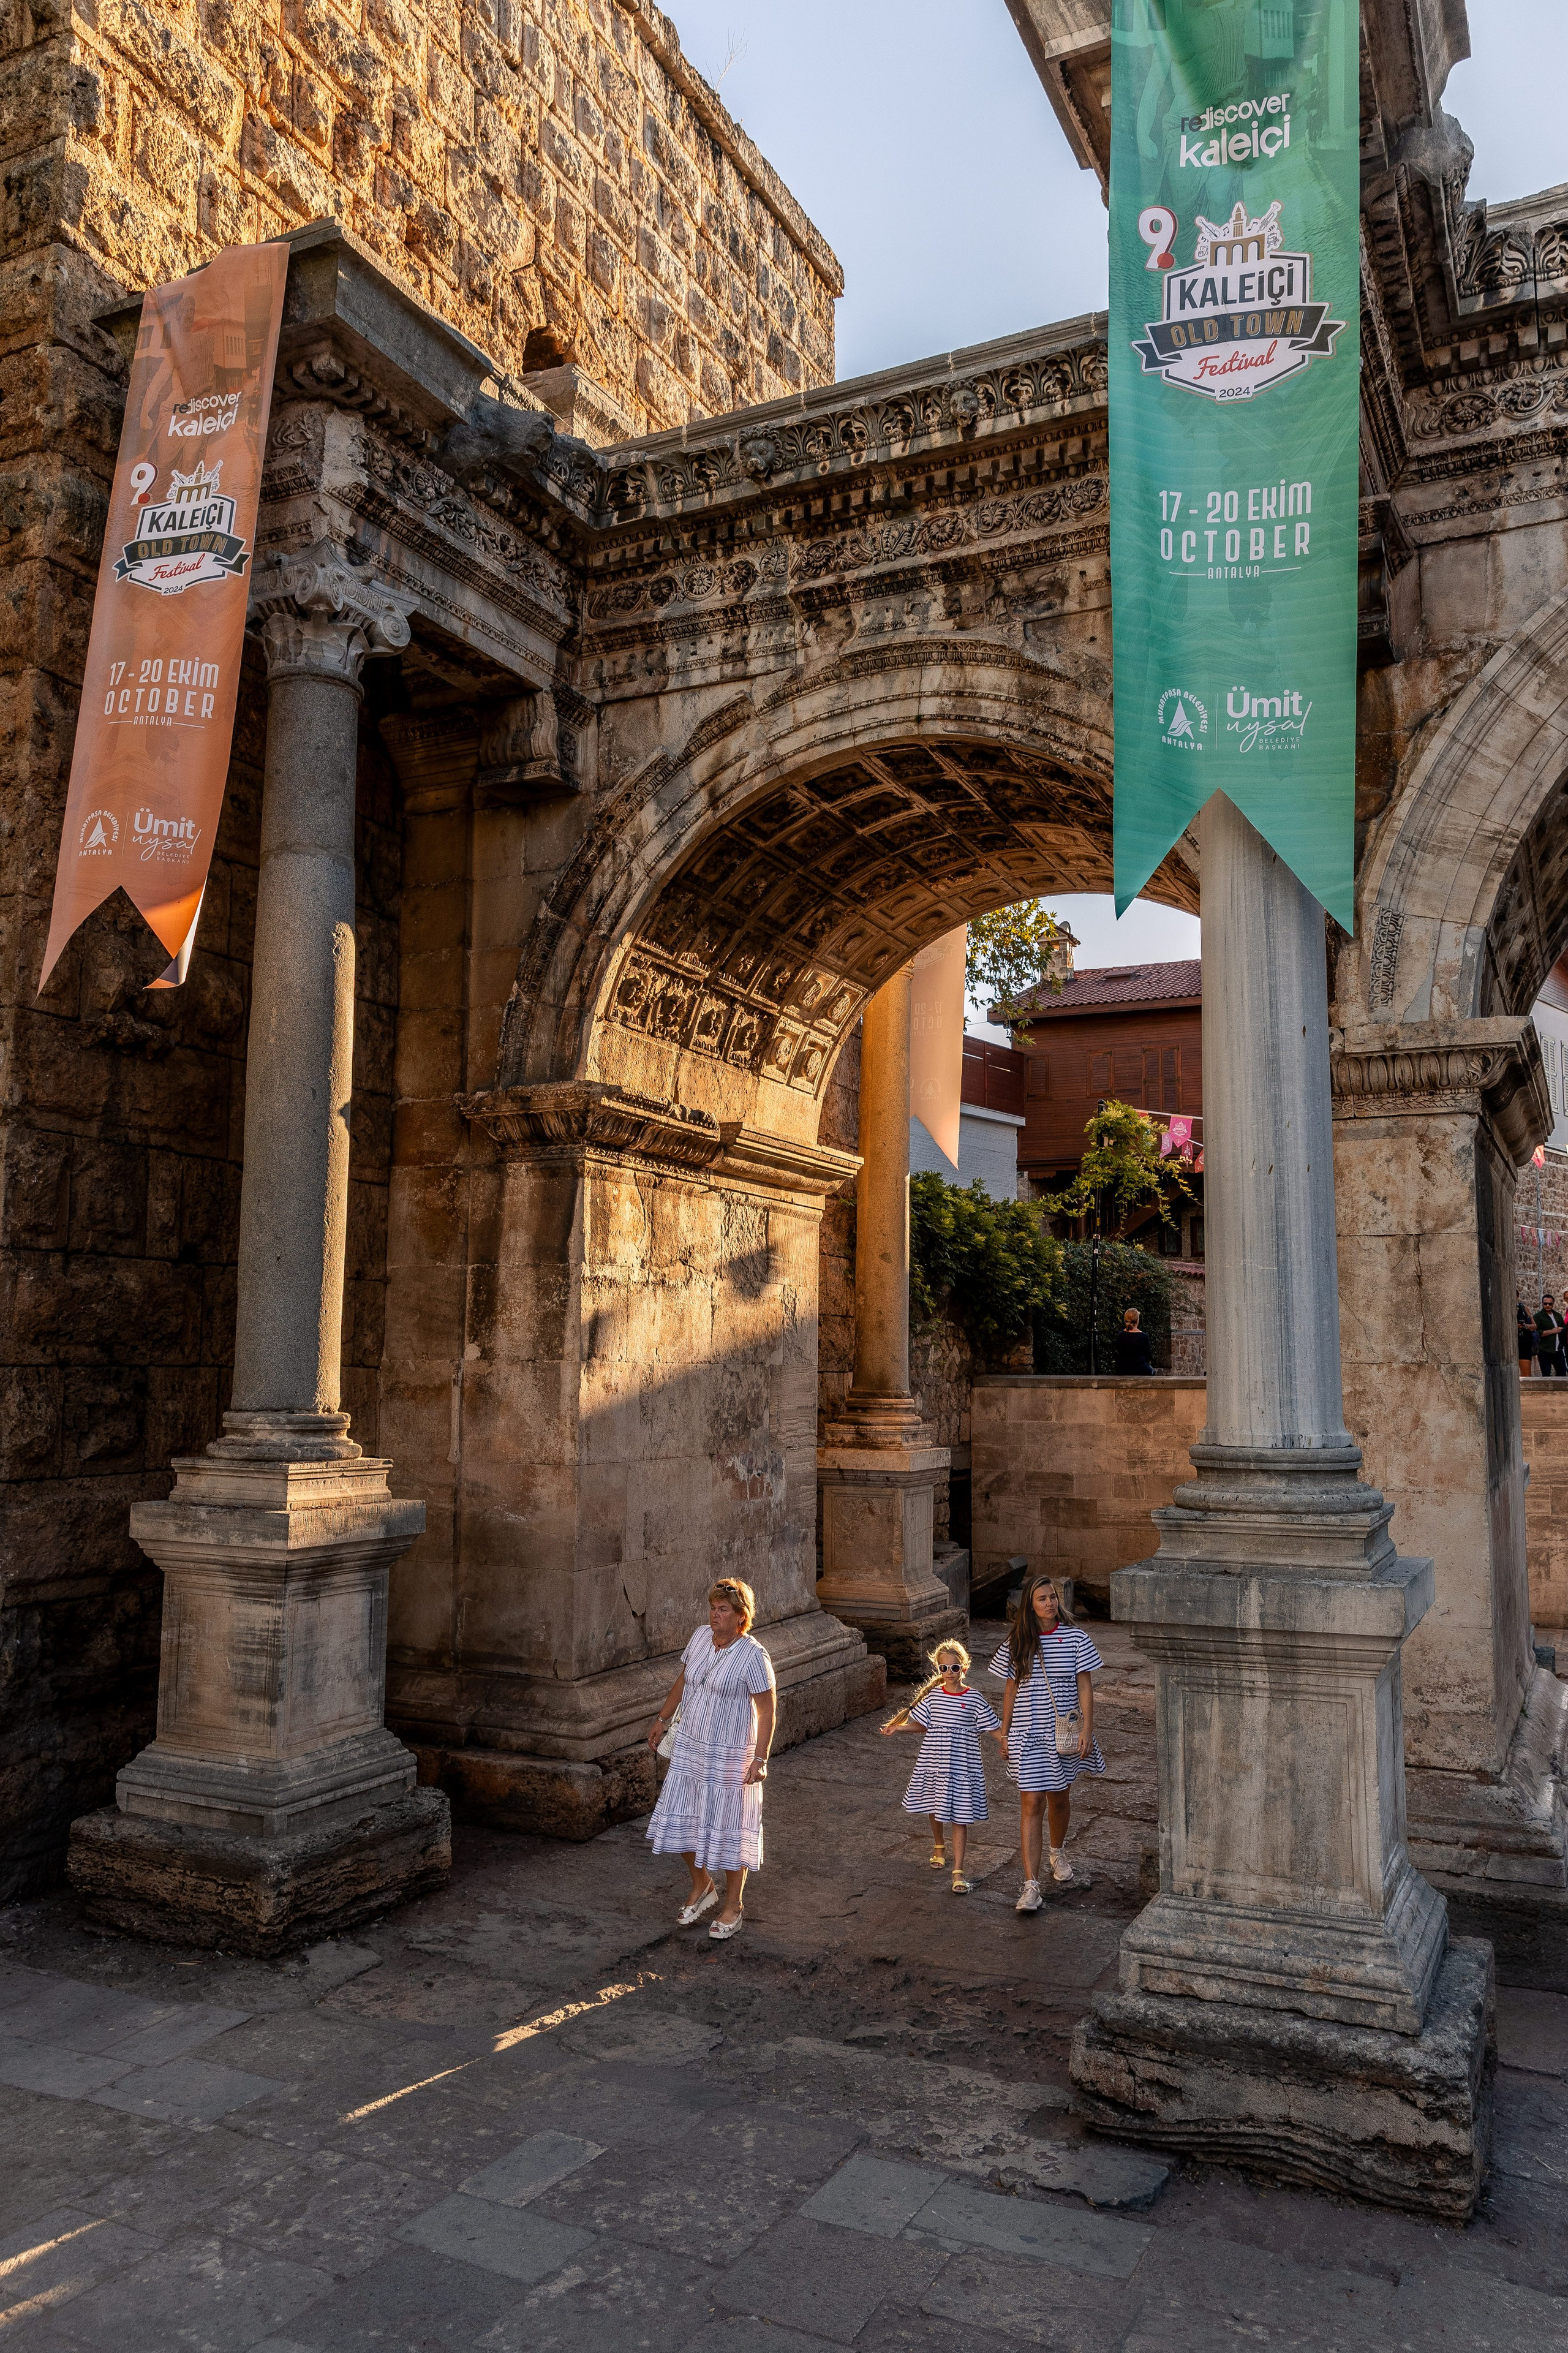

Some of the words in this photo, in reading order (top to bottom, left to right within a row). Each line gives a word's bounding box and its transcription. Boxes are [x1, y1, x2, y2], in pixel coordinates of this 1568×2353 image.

[1181, 93, 1291, 132] rediscover
[1180, 115, 1291, 167] kaleiçi
[1170, 319, 1219, 348] OLD
[1229, 311, 1304, 337] TOWN
[1193, 340, 1278, 380] Festival
[172, 391, 242, 414] rediscover
[1218, 387, 1251, 398] 2024
[167, 403, 239, 437] kaleiçi
[1159, 490, 1182, 523] 17
[1207, 491, 1238, 523] 20
[1248, 479, 1311, 521] EKİM
[138, 539, 173, 559] OLD
[181, 534, 228, 554] TOWN
[1161, 522, 1310, 563] OCTOBER
[148, 553, 206, 581] Festival
[1208, 565, 1259, 580] ANTALYA
[164, 585, 183, 594] 2024
[110, 661, 126, 686] 17
[139, 659, 163, 683] 20
[167, 657, 219, 688] EKİM
[104, 687, 214, 719] OCTOBER
[1158, 689, 1182, 724] MURATPAŞA
[1183, 691, 1208, 733] BELEDİYESİ
[1227, 686, 1303, 719] Ümit
[134, 716, 172, 727] ANTALYA
[1162, 735, 1202, 750] ANTALYA
[134, 807, 195, 839] Ümit
